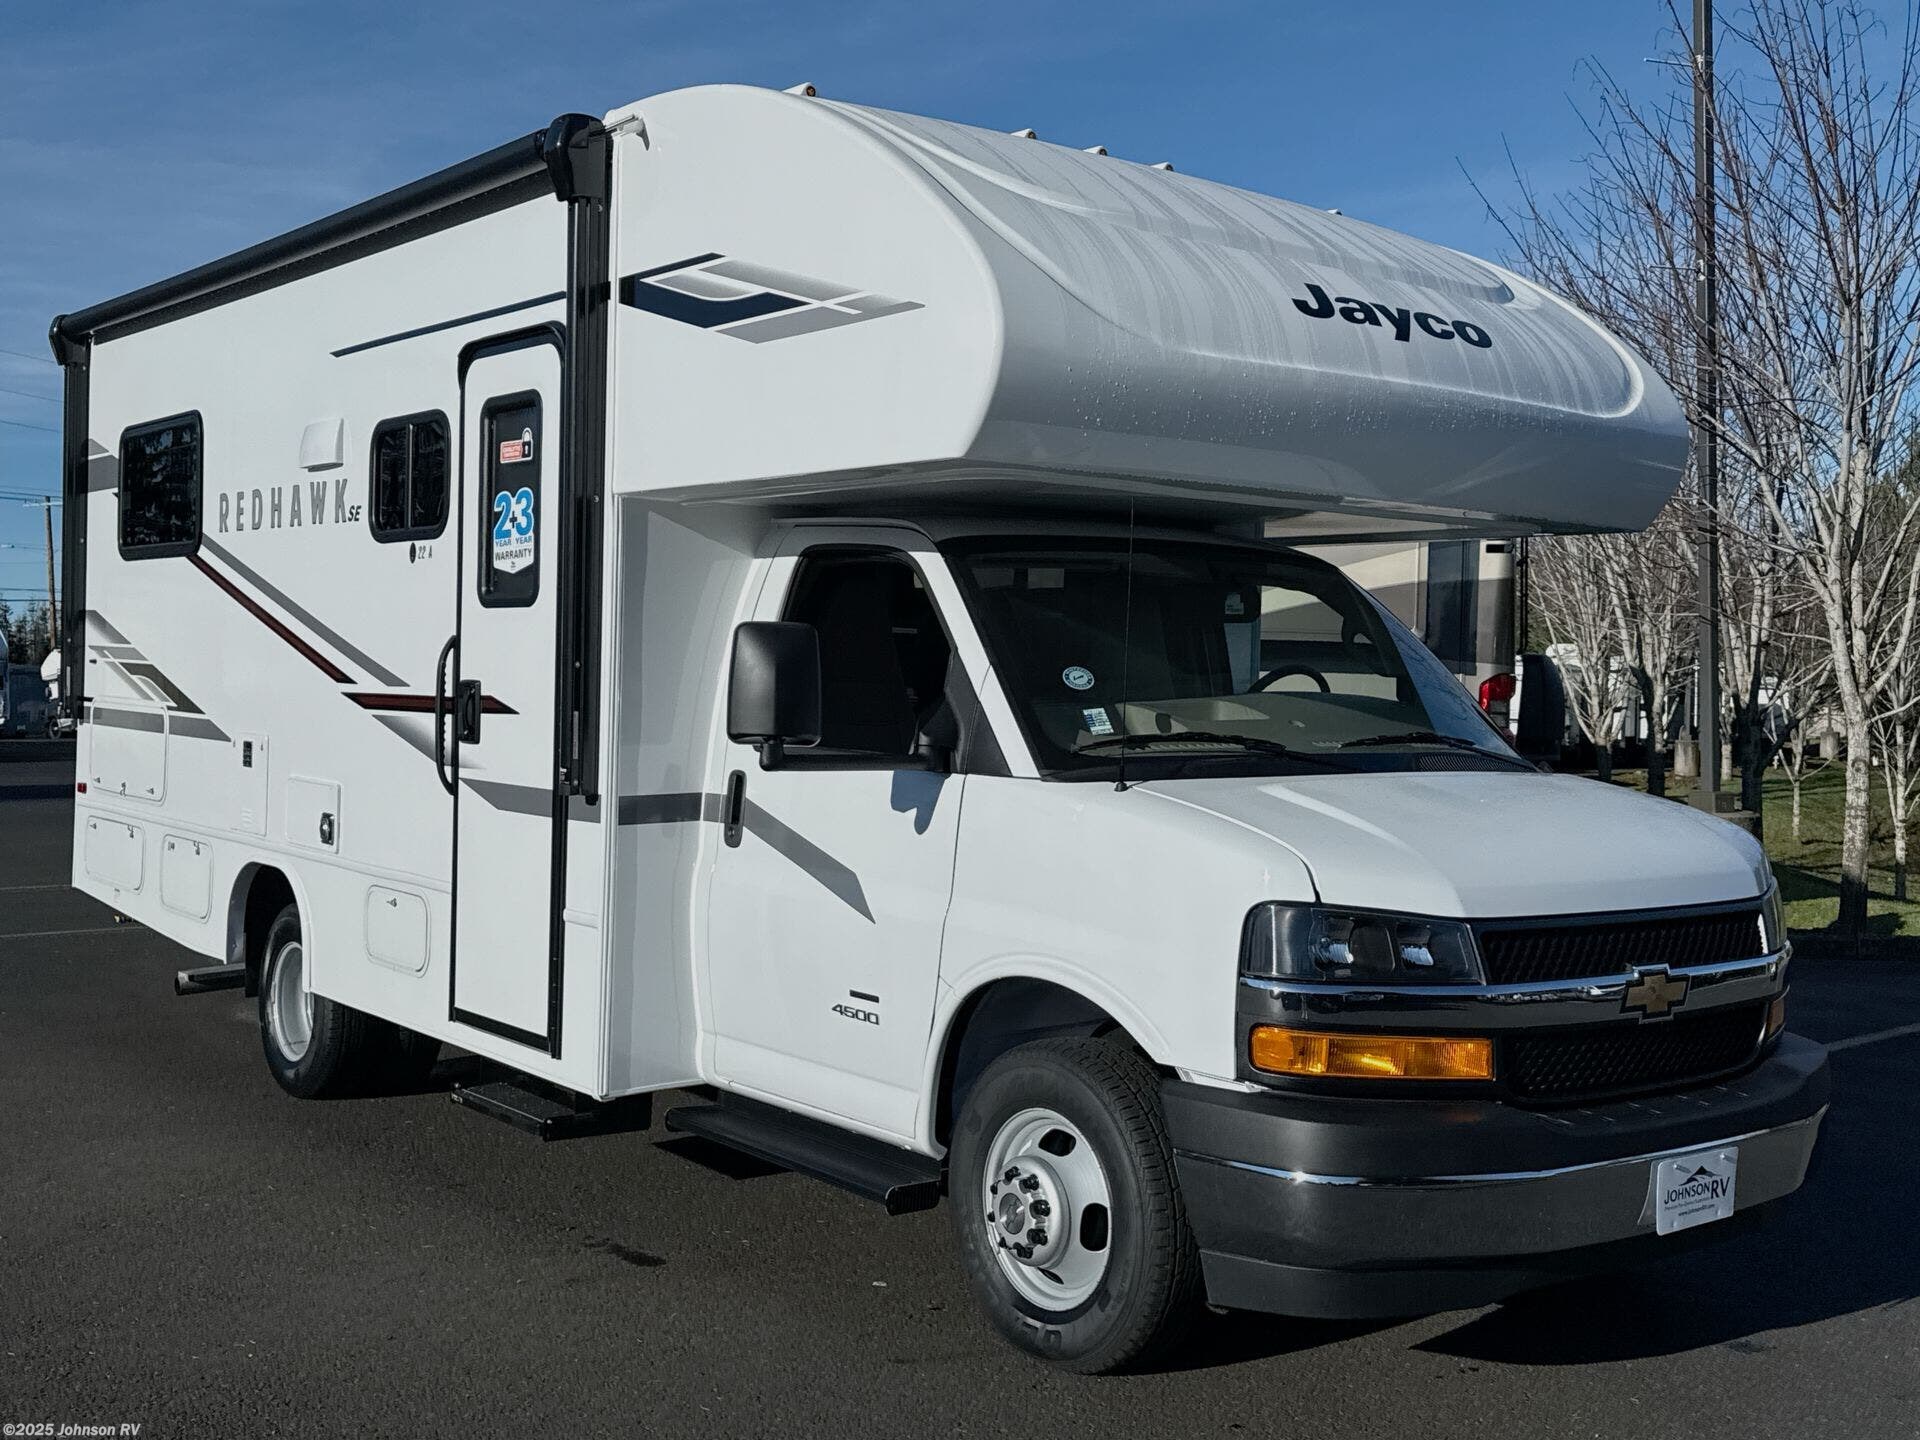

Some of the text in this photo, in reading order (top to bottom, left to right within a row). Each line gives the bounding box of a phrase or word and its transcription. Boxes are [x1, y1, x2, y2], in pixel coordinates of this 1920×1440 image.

[1291, 282, 1493, 348] Jayco
[219, 478, 362, 533] REDHAWK SE
[418, 545, 433, 559] 22 A
[495, 535, 532, 547] YEAR YEAR
[495, 547, 532, 561] WARRANTY
[832, 1003, 880, 1026] 4500
[1664, 1182, 1711, 1205] JOHNSON
[1711, 1176, 1730, 1199] RV
